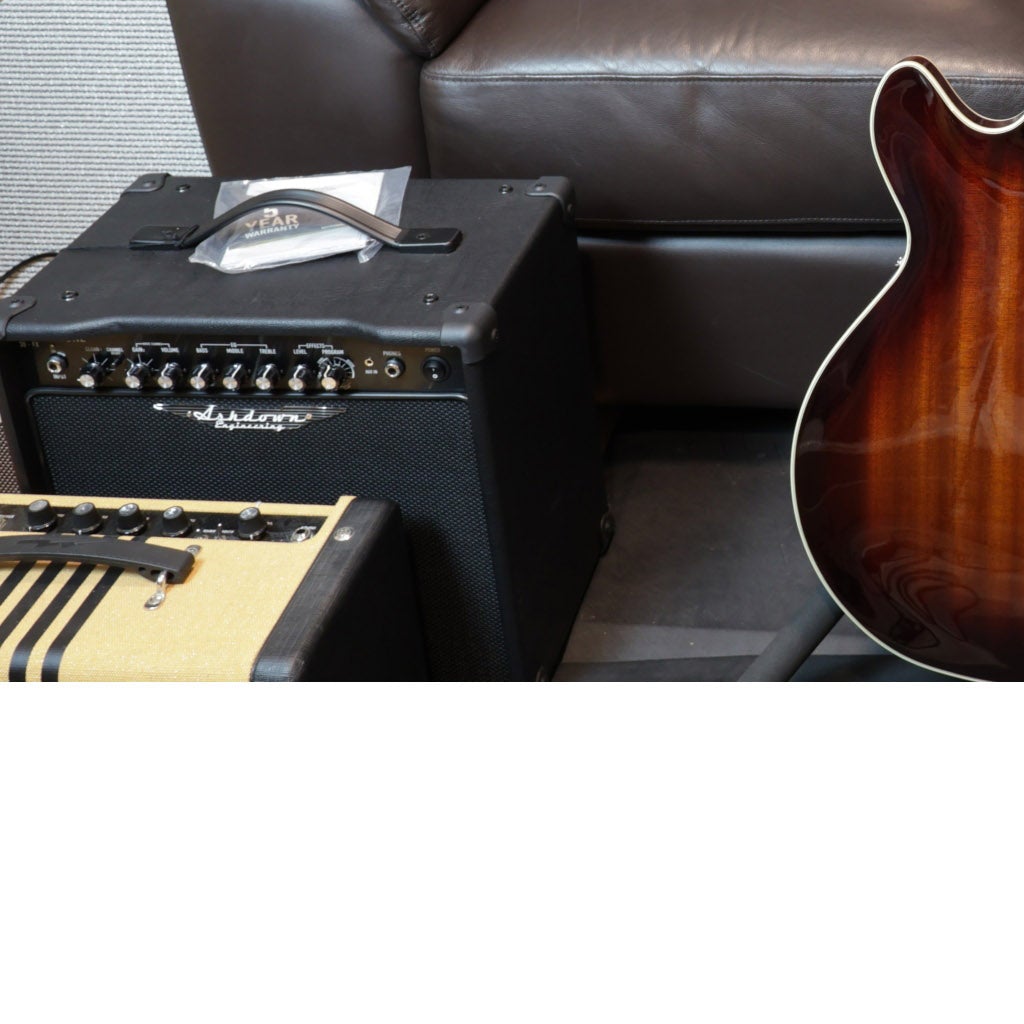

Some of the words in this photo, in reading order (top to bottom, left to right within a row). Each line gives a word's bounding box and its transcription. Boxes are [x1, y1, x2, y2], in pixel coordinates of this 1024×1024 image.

[245, 214, 299, 230] YEAR
[244, 223, 300, 239] WARRANTY
[193, 404, 307, 423] Ashdown
[215, 421, 285, 432] Engineering
